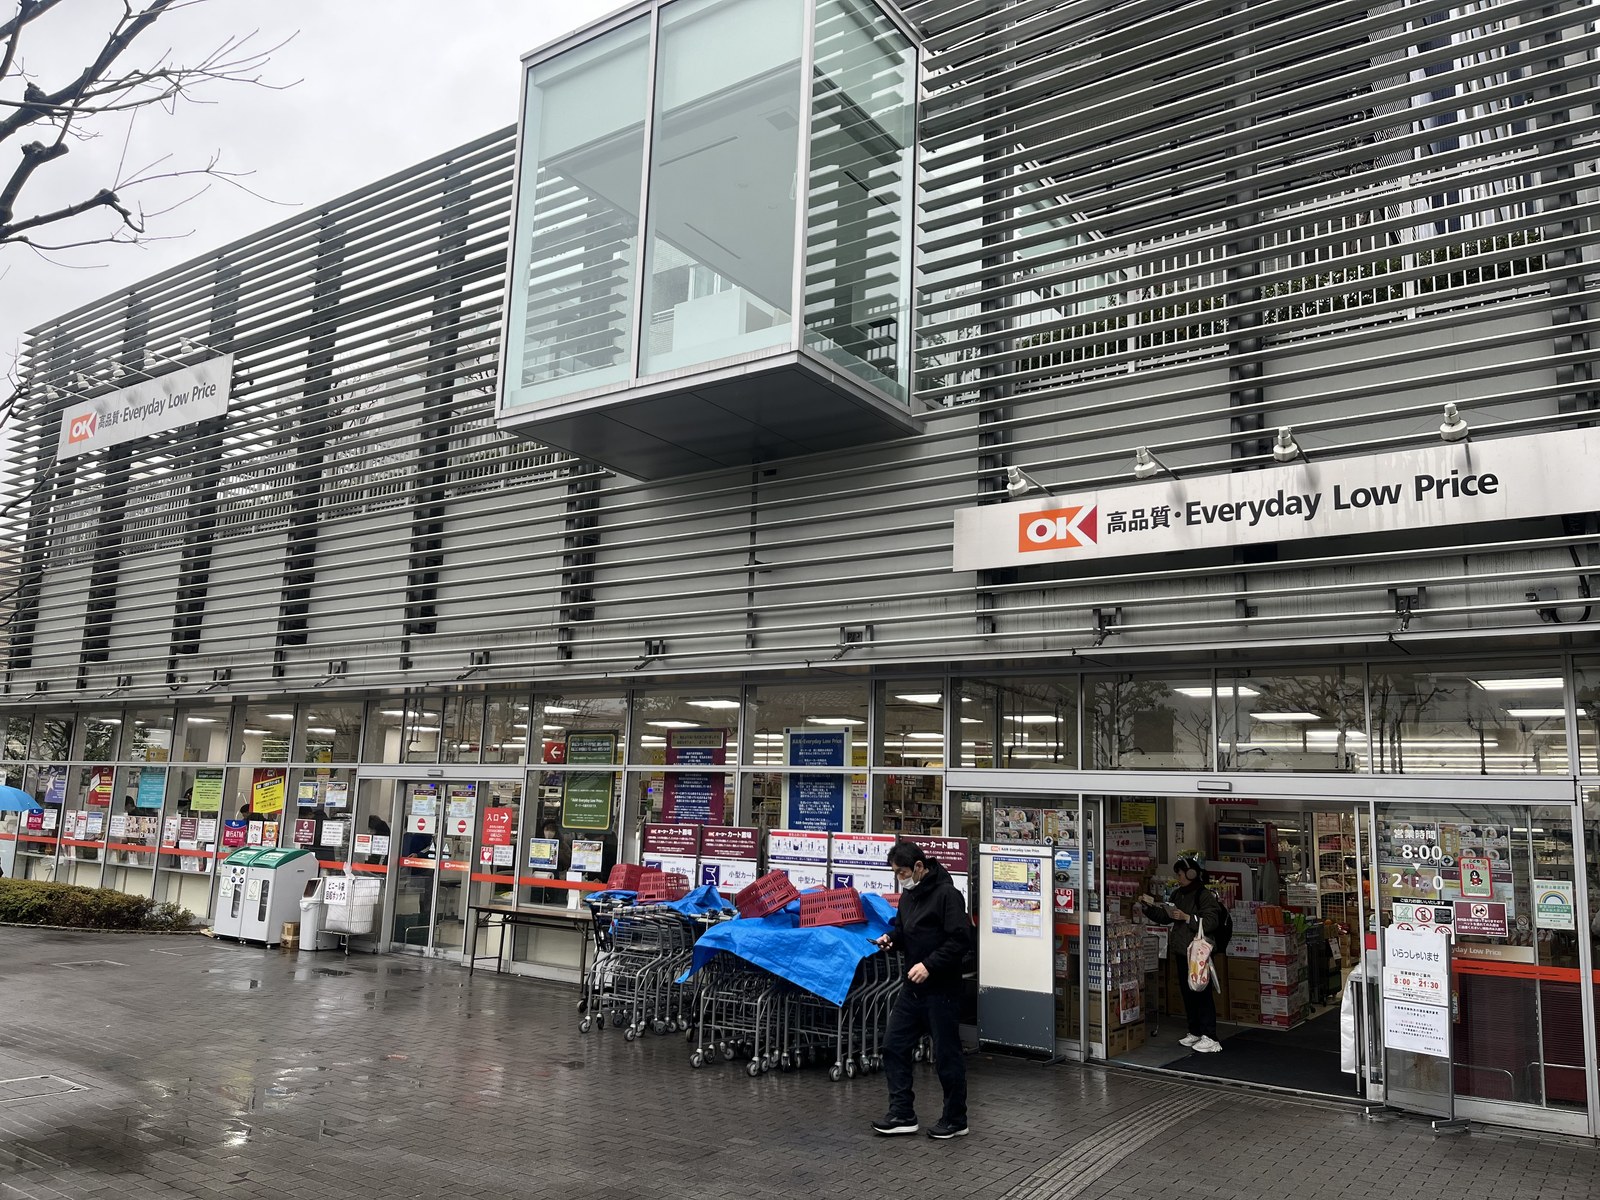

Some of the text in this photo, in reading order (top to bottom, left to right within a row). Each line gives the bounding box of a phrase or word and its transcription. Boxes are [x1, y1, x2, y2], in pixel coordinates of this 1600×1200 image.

[72, 412, 97, 438] OK
[168, 392, 189, 409] Low
[192, 382, 216, 402] Price
[1026, 505, 1098, 546] OK
[1333, 482, 1401, 511] Low
[1414, 468, 1500, 502] Price
[486, 814, 499, 822] 入口
[1394, 829, 1436, 839] 営業時間
[1402, 844, 1442, 860] 8:00
[798, 876, 826, 884] 中型カート
[864, 880, 894, 890] 小型カート
[1392, 874, 1443, 890] 2:0
[1392, 948, 1439, 962] いらっしゃいませ
[1394, 977, 1410, 985] 8:00
[1418, 981, 1439, 989] 21:30
